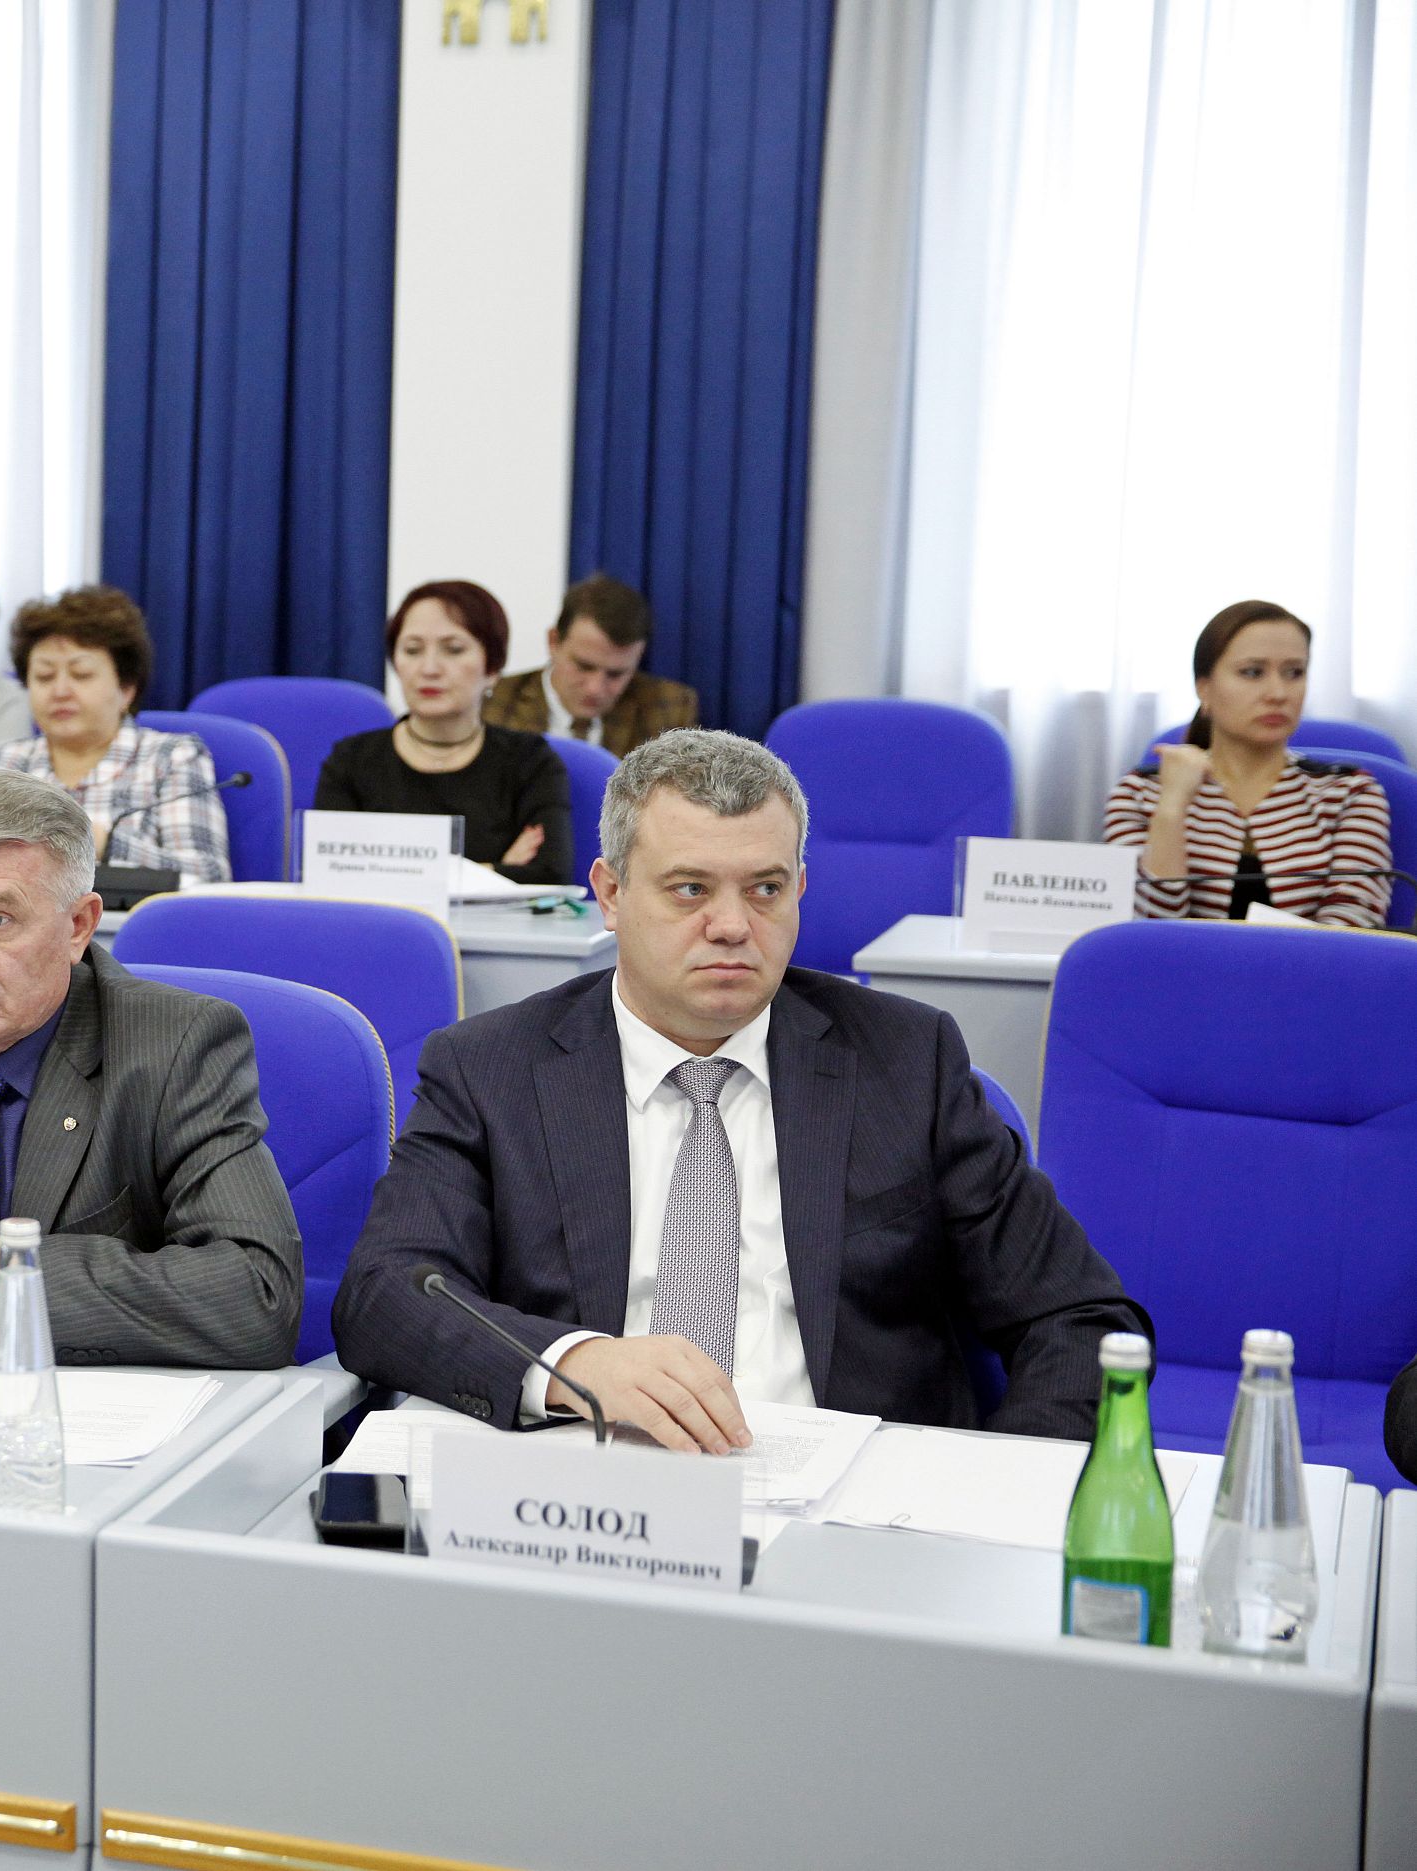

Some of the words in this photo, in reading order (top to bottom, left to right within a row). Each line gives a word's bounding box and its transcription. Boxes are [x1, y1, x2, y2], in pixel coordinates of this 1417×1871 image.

[318, 842, 437, 859] ВЕРЕМЕЕНКО
[994, 872, 1107, 892] ПАВЛЕНКО
[515, 1498, 650, 1543] СОЛОД
[444, 1530, 568, 1565] Александр
[576, 1545, 722, 1580] Викторович
